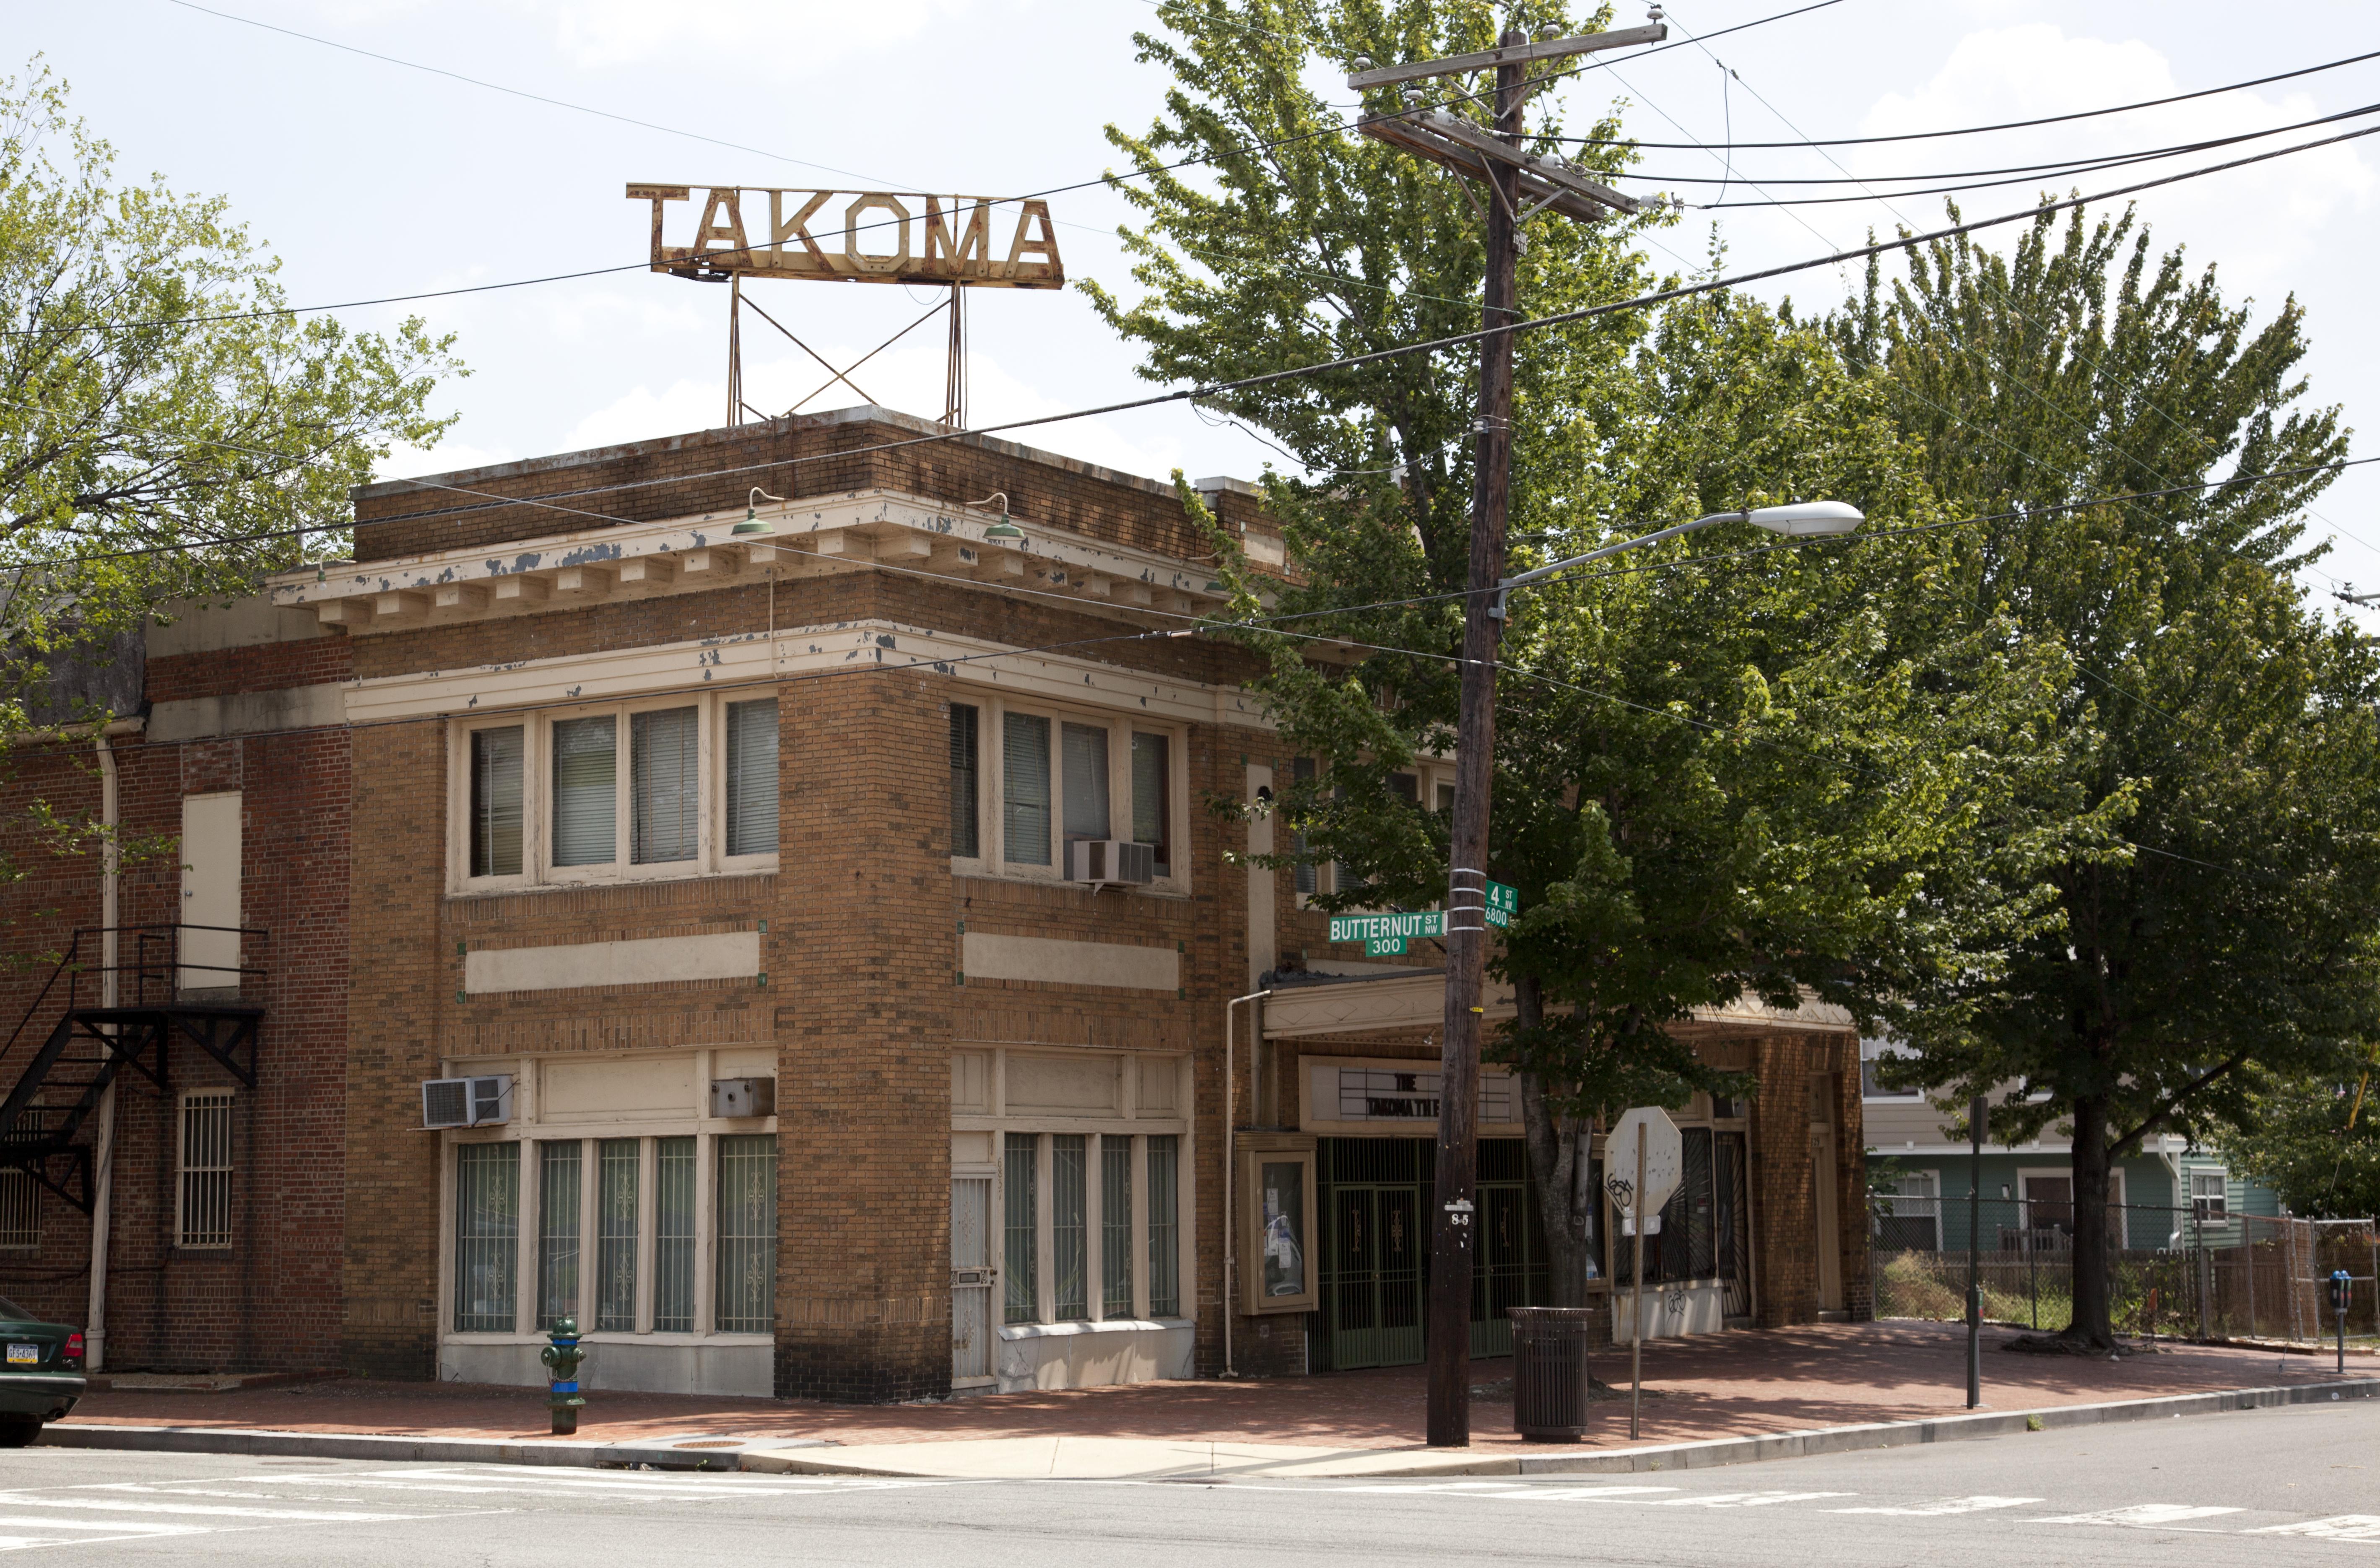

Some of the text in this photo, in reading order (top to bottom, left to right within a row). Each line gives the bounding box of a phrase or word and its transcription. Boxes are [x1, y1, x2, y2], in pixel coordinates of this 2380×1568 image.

[626, 182, 1063, 280] TAKOMA
[1491, 885, 1512, 906] 4 ST
[1505, 900, 1512, 910] NW
[1485, 906, 1507, 926] 6800
[1330, 915, 1438, 940] BUTTERNUT ST
[1425, 925, 1438, 935] NW
[1372, 938, 1400, 954] 300
[1395, 1073, 1417, 1092] THE
